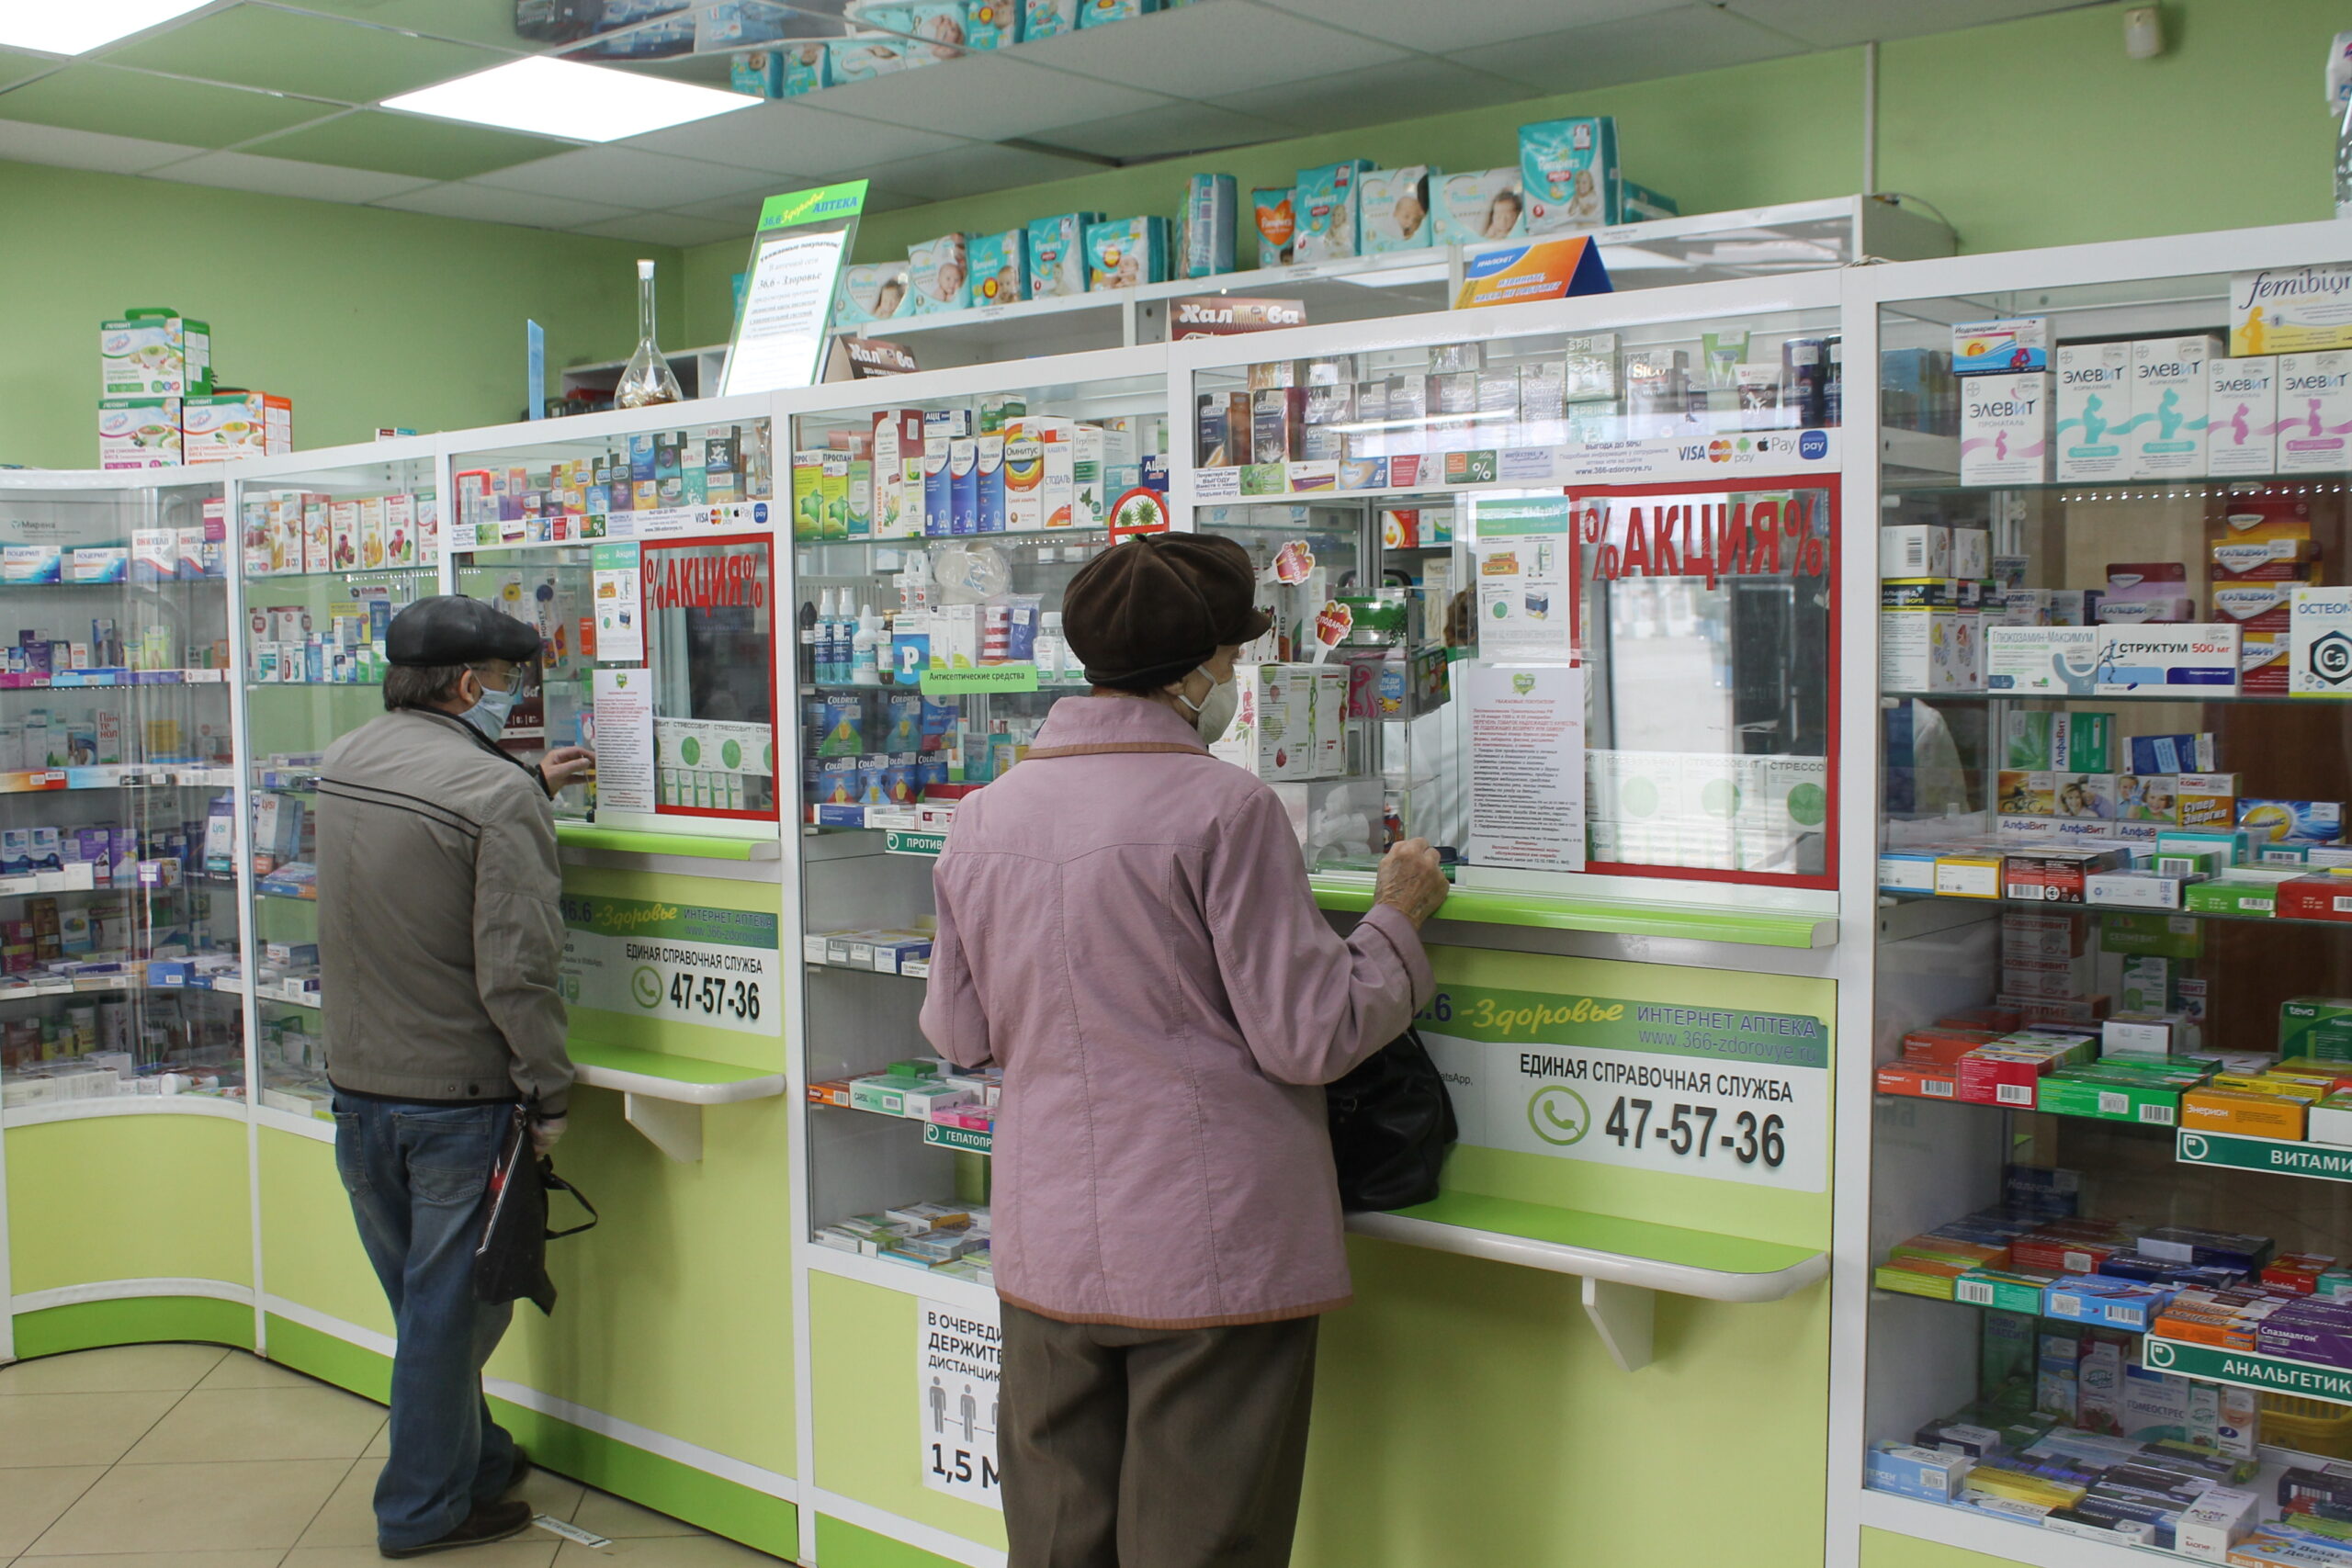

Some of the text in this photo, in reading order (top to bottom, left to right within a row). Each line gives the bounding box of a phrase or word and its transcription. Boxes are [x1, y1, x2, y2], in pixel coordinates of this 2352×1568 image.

[1537, 156, 1579, 171] Pampers
[781, 191, 825, 223] Здоровье
[812, 197, 857, 214] АПТЕКА
[1304, 195, 1338, 208] Pampers
[1261, 218, 1292, 229] Pampers
[1502, 288, 1514, 299] НЕ
[103, 400, 130, 409] ЛЕОВИТ
[925, 412, 940, 421] АЦЦ
[1006, 446, 1038, 458] Омнитус
[1678, 437, 1796, 464] VISA pay Pay
[1803, 441, 1825, 454] pay
[822, 452, 852, 462] ПРОСПАН
[695, 513, 709, 524] VISA
[22, 521, 56, 530] Мирена
[2120, 643, 2231, 654] СТРУКТУМ 500 мг
[2323, 649, 2346, 666] Ca
[929, 671, 1024, 682] Антисептические средства
[828, 695, 858, 705] COLDREX
[673, 721, 709, 730] СТРЕССОВИТ
[714, 724, 752, 733] СТРЕССОВИТ
[2056, 719, 2066, 766] АлфаВит
[2183, 799, 2216, 814] Супер
[2183, 809, 2227, 826] Энергия
[2003, 820, 2049, 831] АлфаВит
[2060, 824, 2107, 836] АлфаВит
[2121, 826, 2155, 837] АлфаВ
[684, 908, 773, 929] ИНТЕРНЕТ АПТЕКА
[627, 943, 763, 975] ЕДИНАЯ СПРАВОЧНАЯ СЛУЖБА
[670, 972, 761, 1021] 47-57-36
[2289, 1006, 2314, 1016] teva
[1637, 1006, 1817, 1038] ИНТЕРНЕТ АПТЕКА
[1639, 1031, 1816, 1062] www.366-zdorovye.ru
[1438, 1070, 1473, 1086] atsApp,
[1521, 1054, 1793, 1102] ЕДИНАЯ СПРАВОЧНАЯ СЛУЖБА
[2187, 1104, 2229, 1117] Энерион
[1605, 1096, 1785, 1168] 47-57-36
[2270, 1149, 2352, 1173] ВИТАМИ
[928, 1311, 936, 1325] В
[2261, 1325, 2317, 1343] Спазмалгон
[2222, 1359, 2352, 1394] АНАЛЬГЕТИК
[932, 1442, 972, 1484] 1,5
